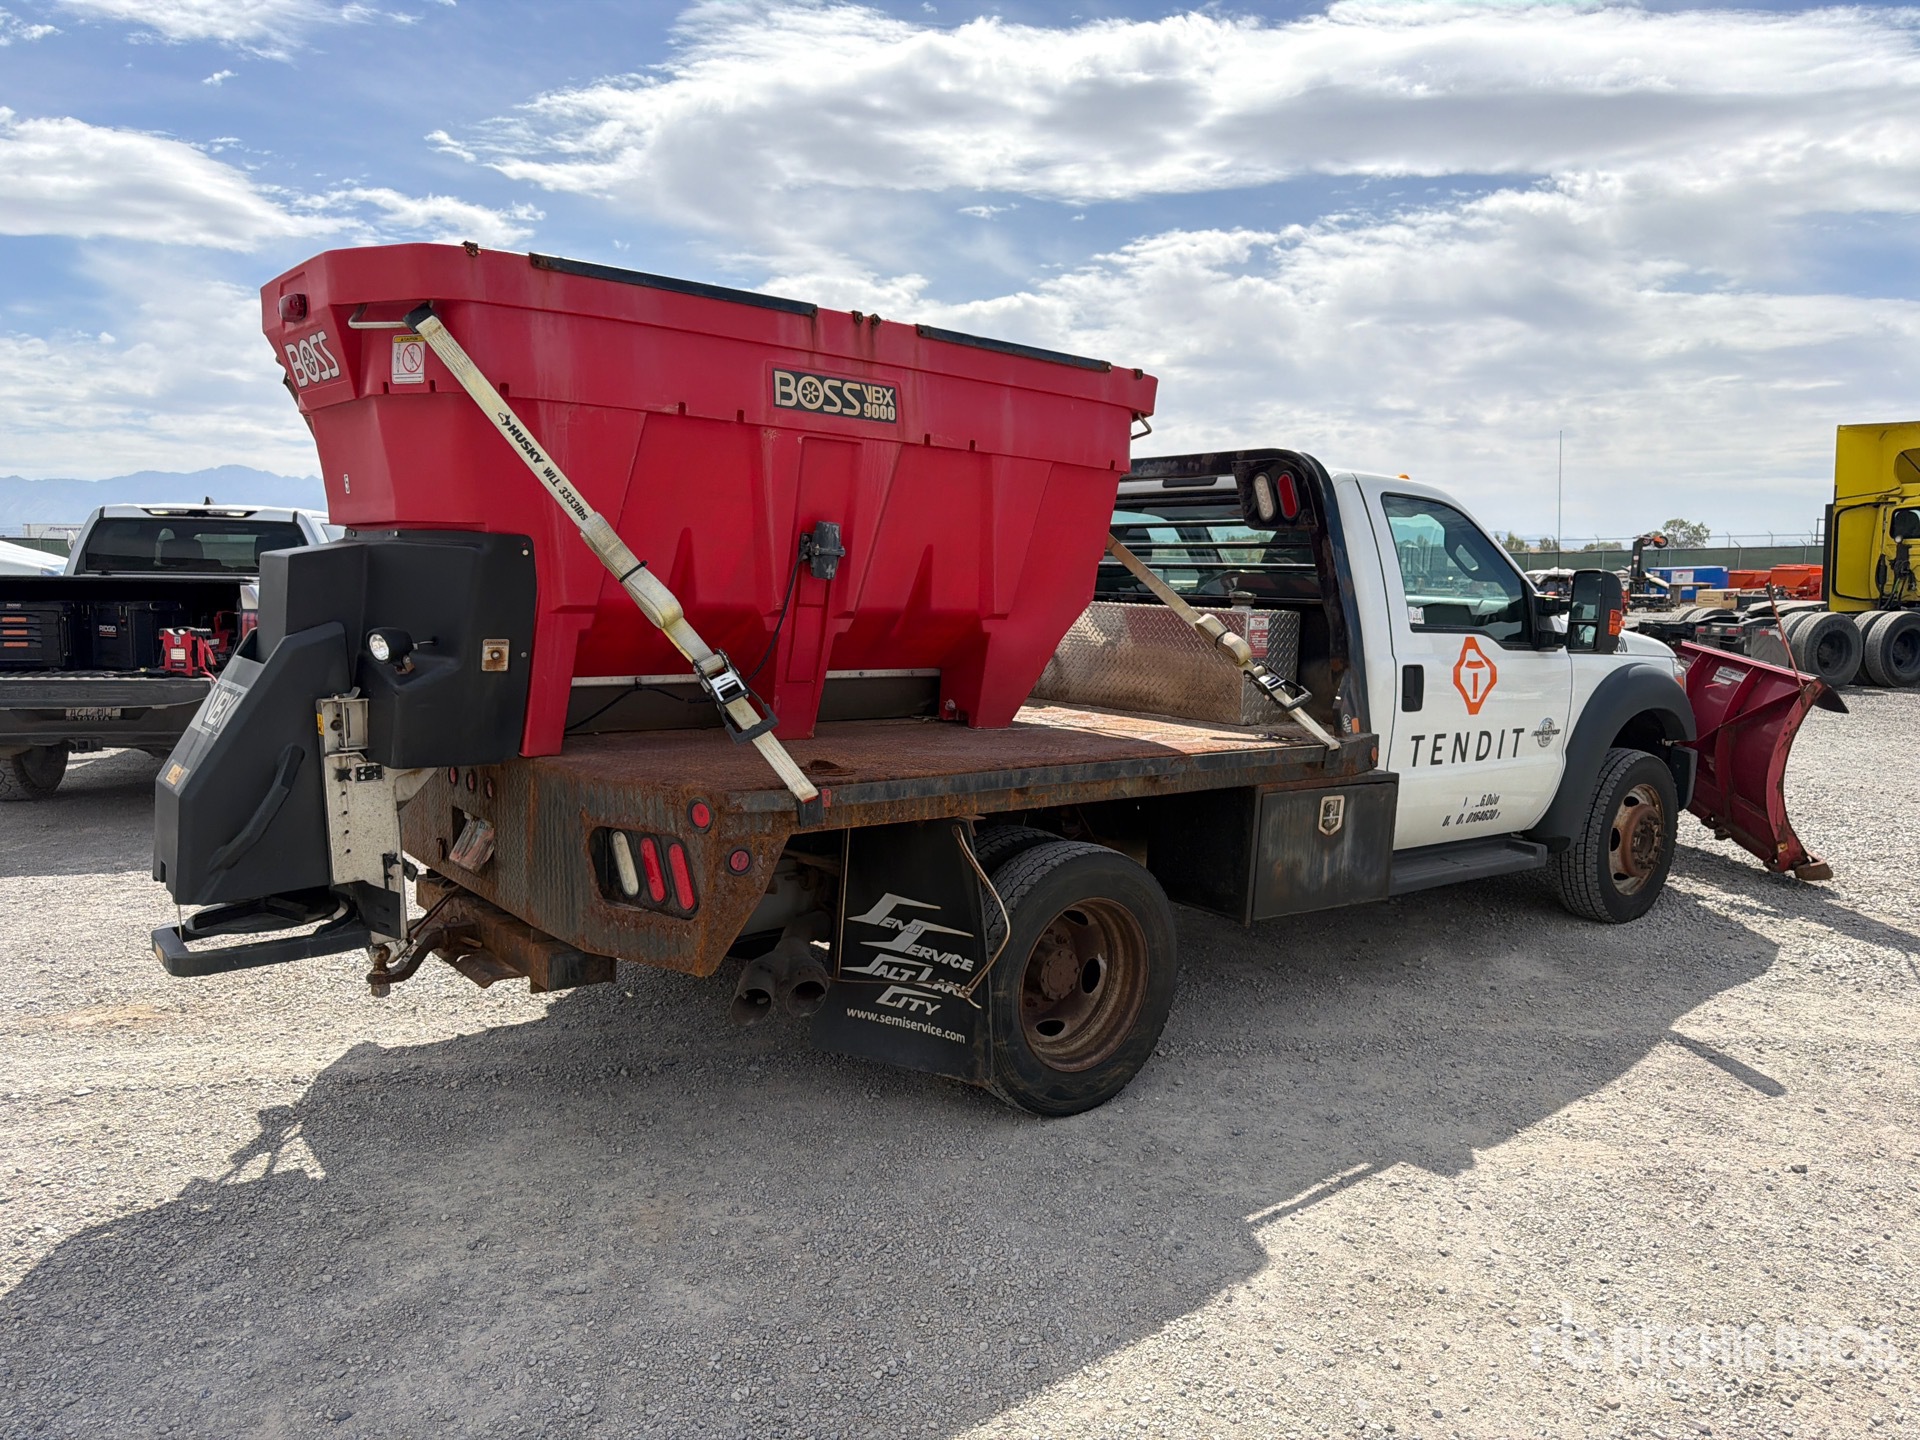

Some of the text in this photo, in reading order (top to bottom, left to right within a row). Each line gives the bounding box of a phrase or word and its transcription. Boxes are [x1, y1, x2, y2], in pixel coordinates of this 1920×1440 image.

[284, 330, 340, 388] BOSS
[774, 370, 862, 416] BOSS
[861, 384, 895, 406] VBX
[863, 403, 896, 421] 9000
[507, 424, 589, 521] HUSKY WLL 3333lbs
[203, 688, 240, 729] VBX
[1410, 728, 1525, 768] TENDIT
[859, 918, 975, 972] SERVICE
[841, 953, 934, 982] SALT
[875, 984, 943, 1016] CITY
[846, 1007, 966, 1044] www.semiservice.com
